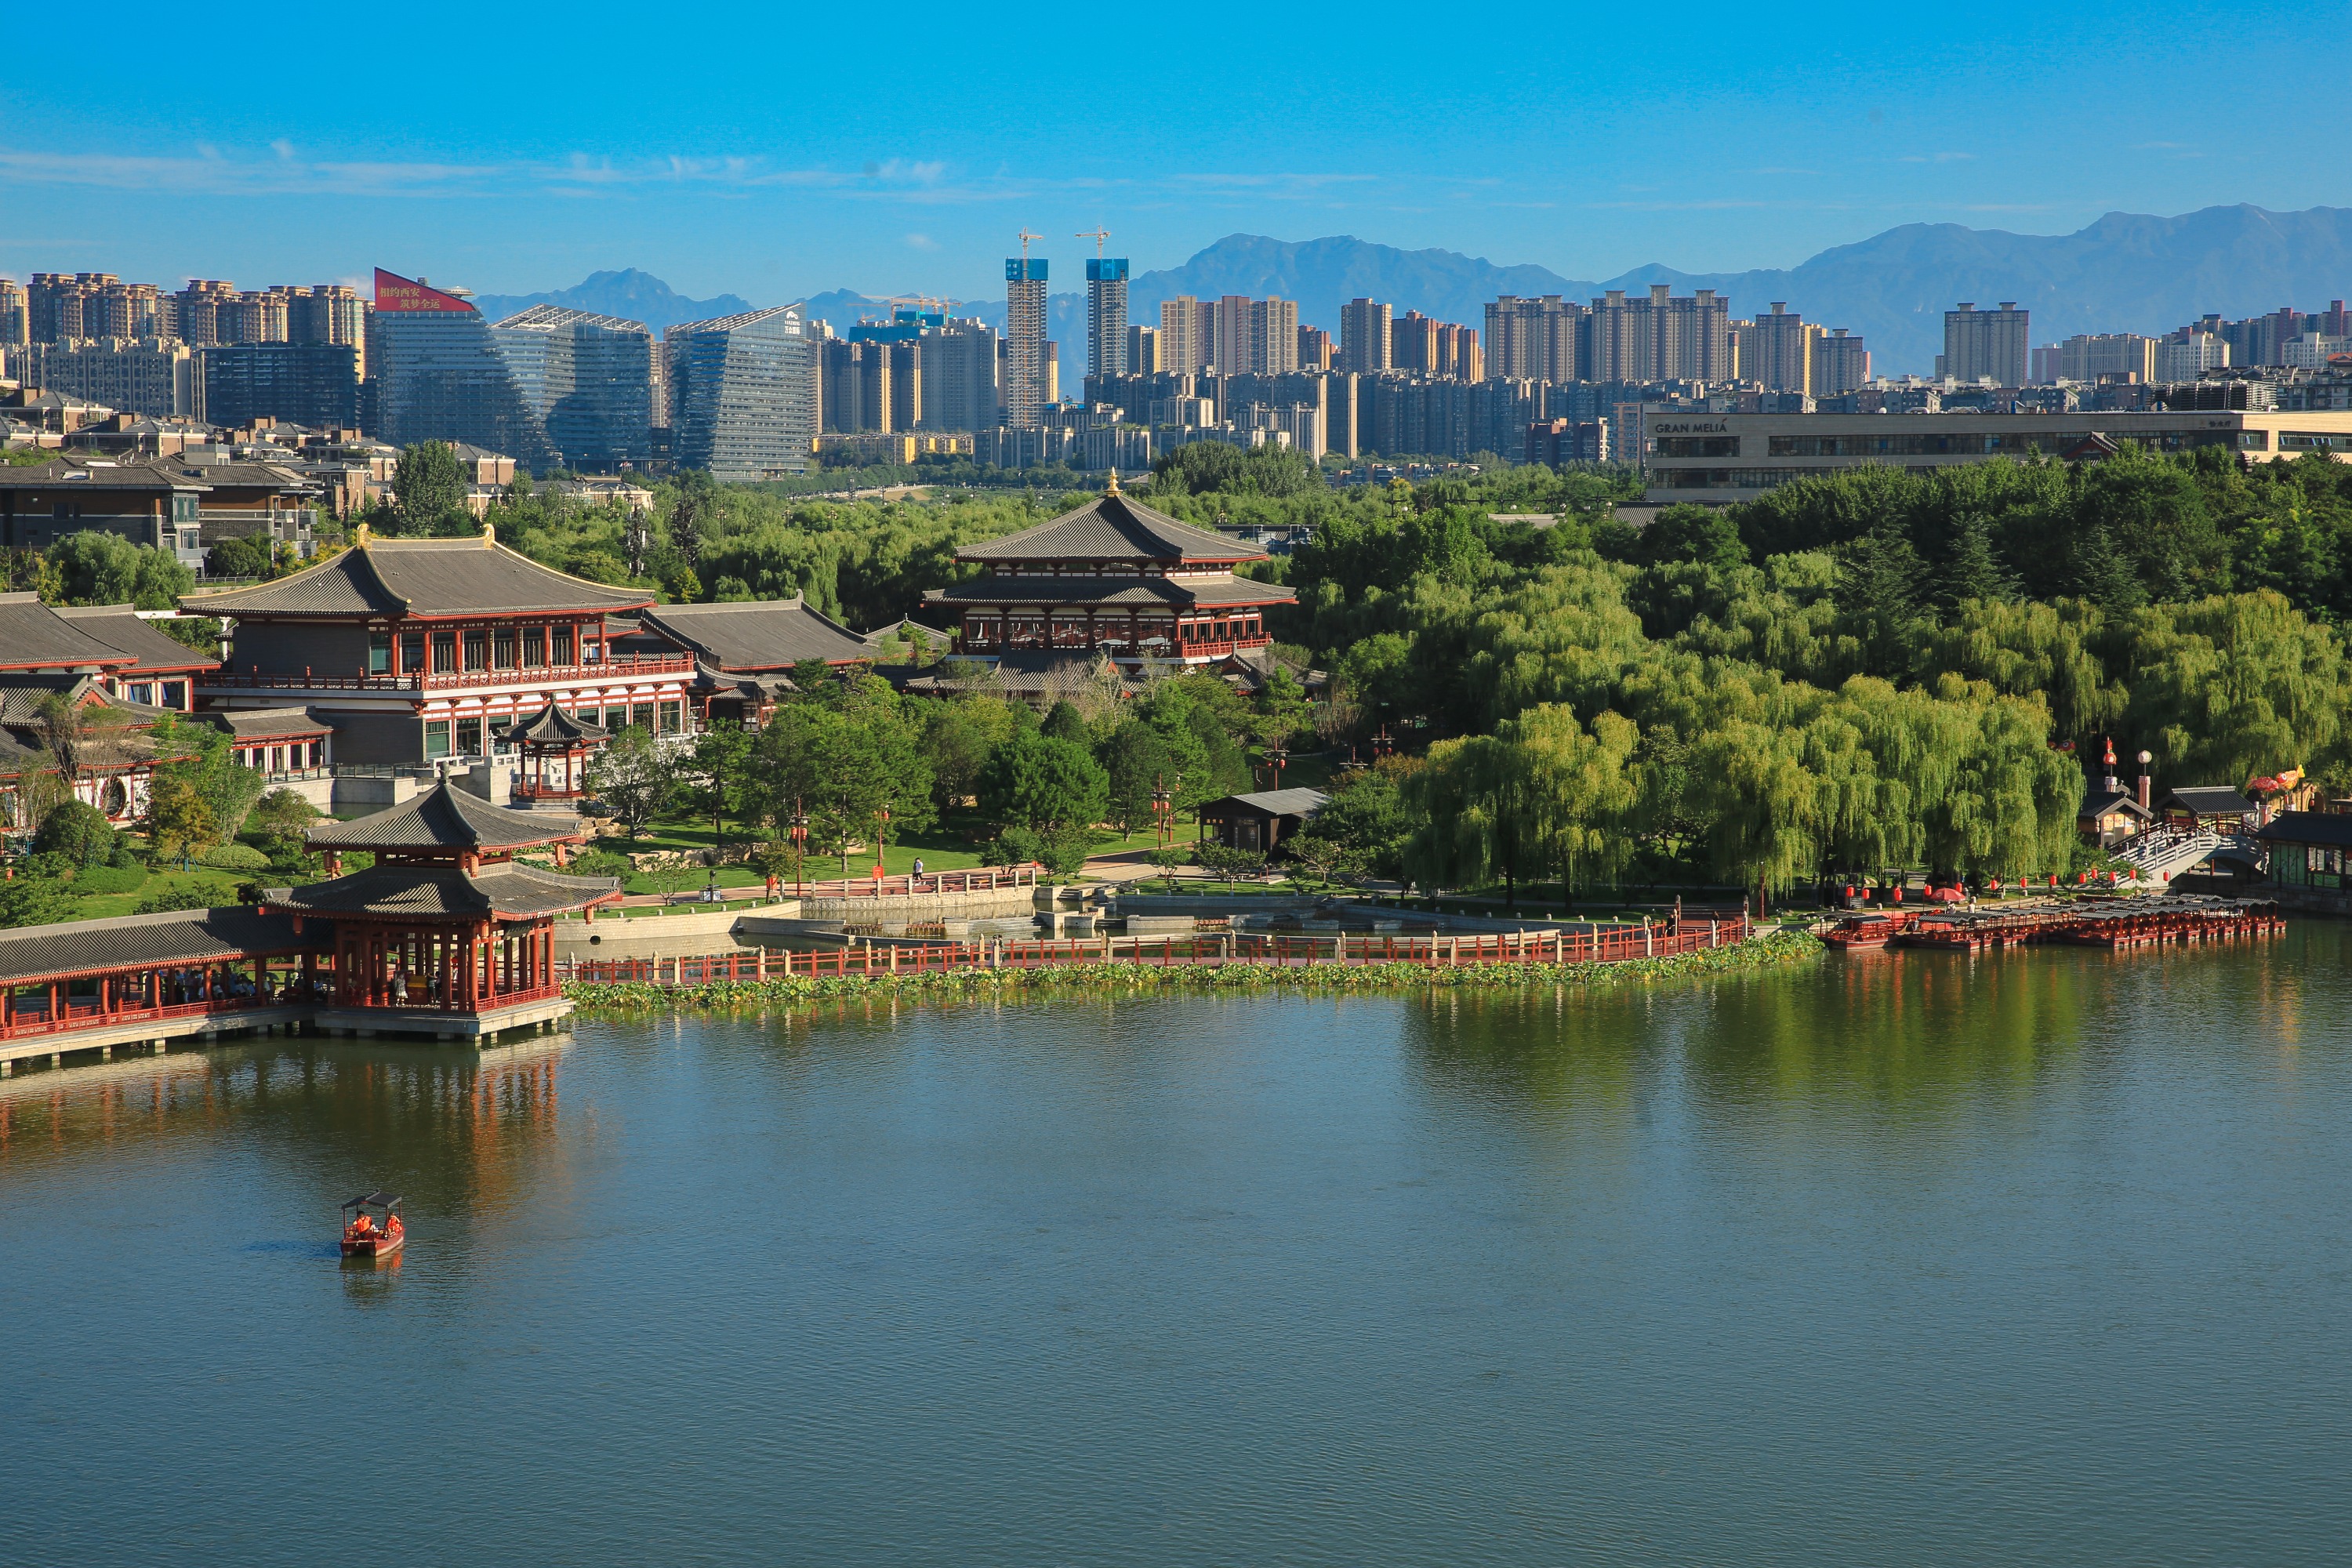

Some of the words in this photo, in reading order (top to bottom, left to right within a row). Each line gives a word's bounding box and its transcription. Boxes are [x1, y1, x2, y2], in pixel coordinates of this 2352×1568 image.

[380, 287, 420, 297] 相约西安
[400, 299, 441, 309] 筑梦全运
[1655, 423, 1689, 433] GRAN
[1693, 417, 1727, 433] MELIÁ
